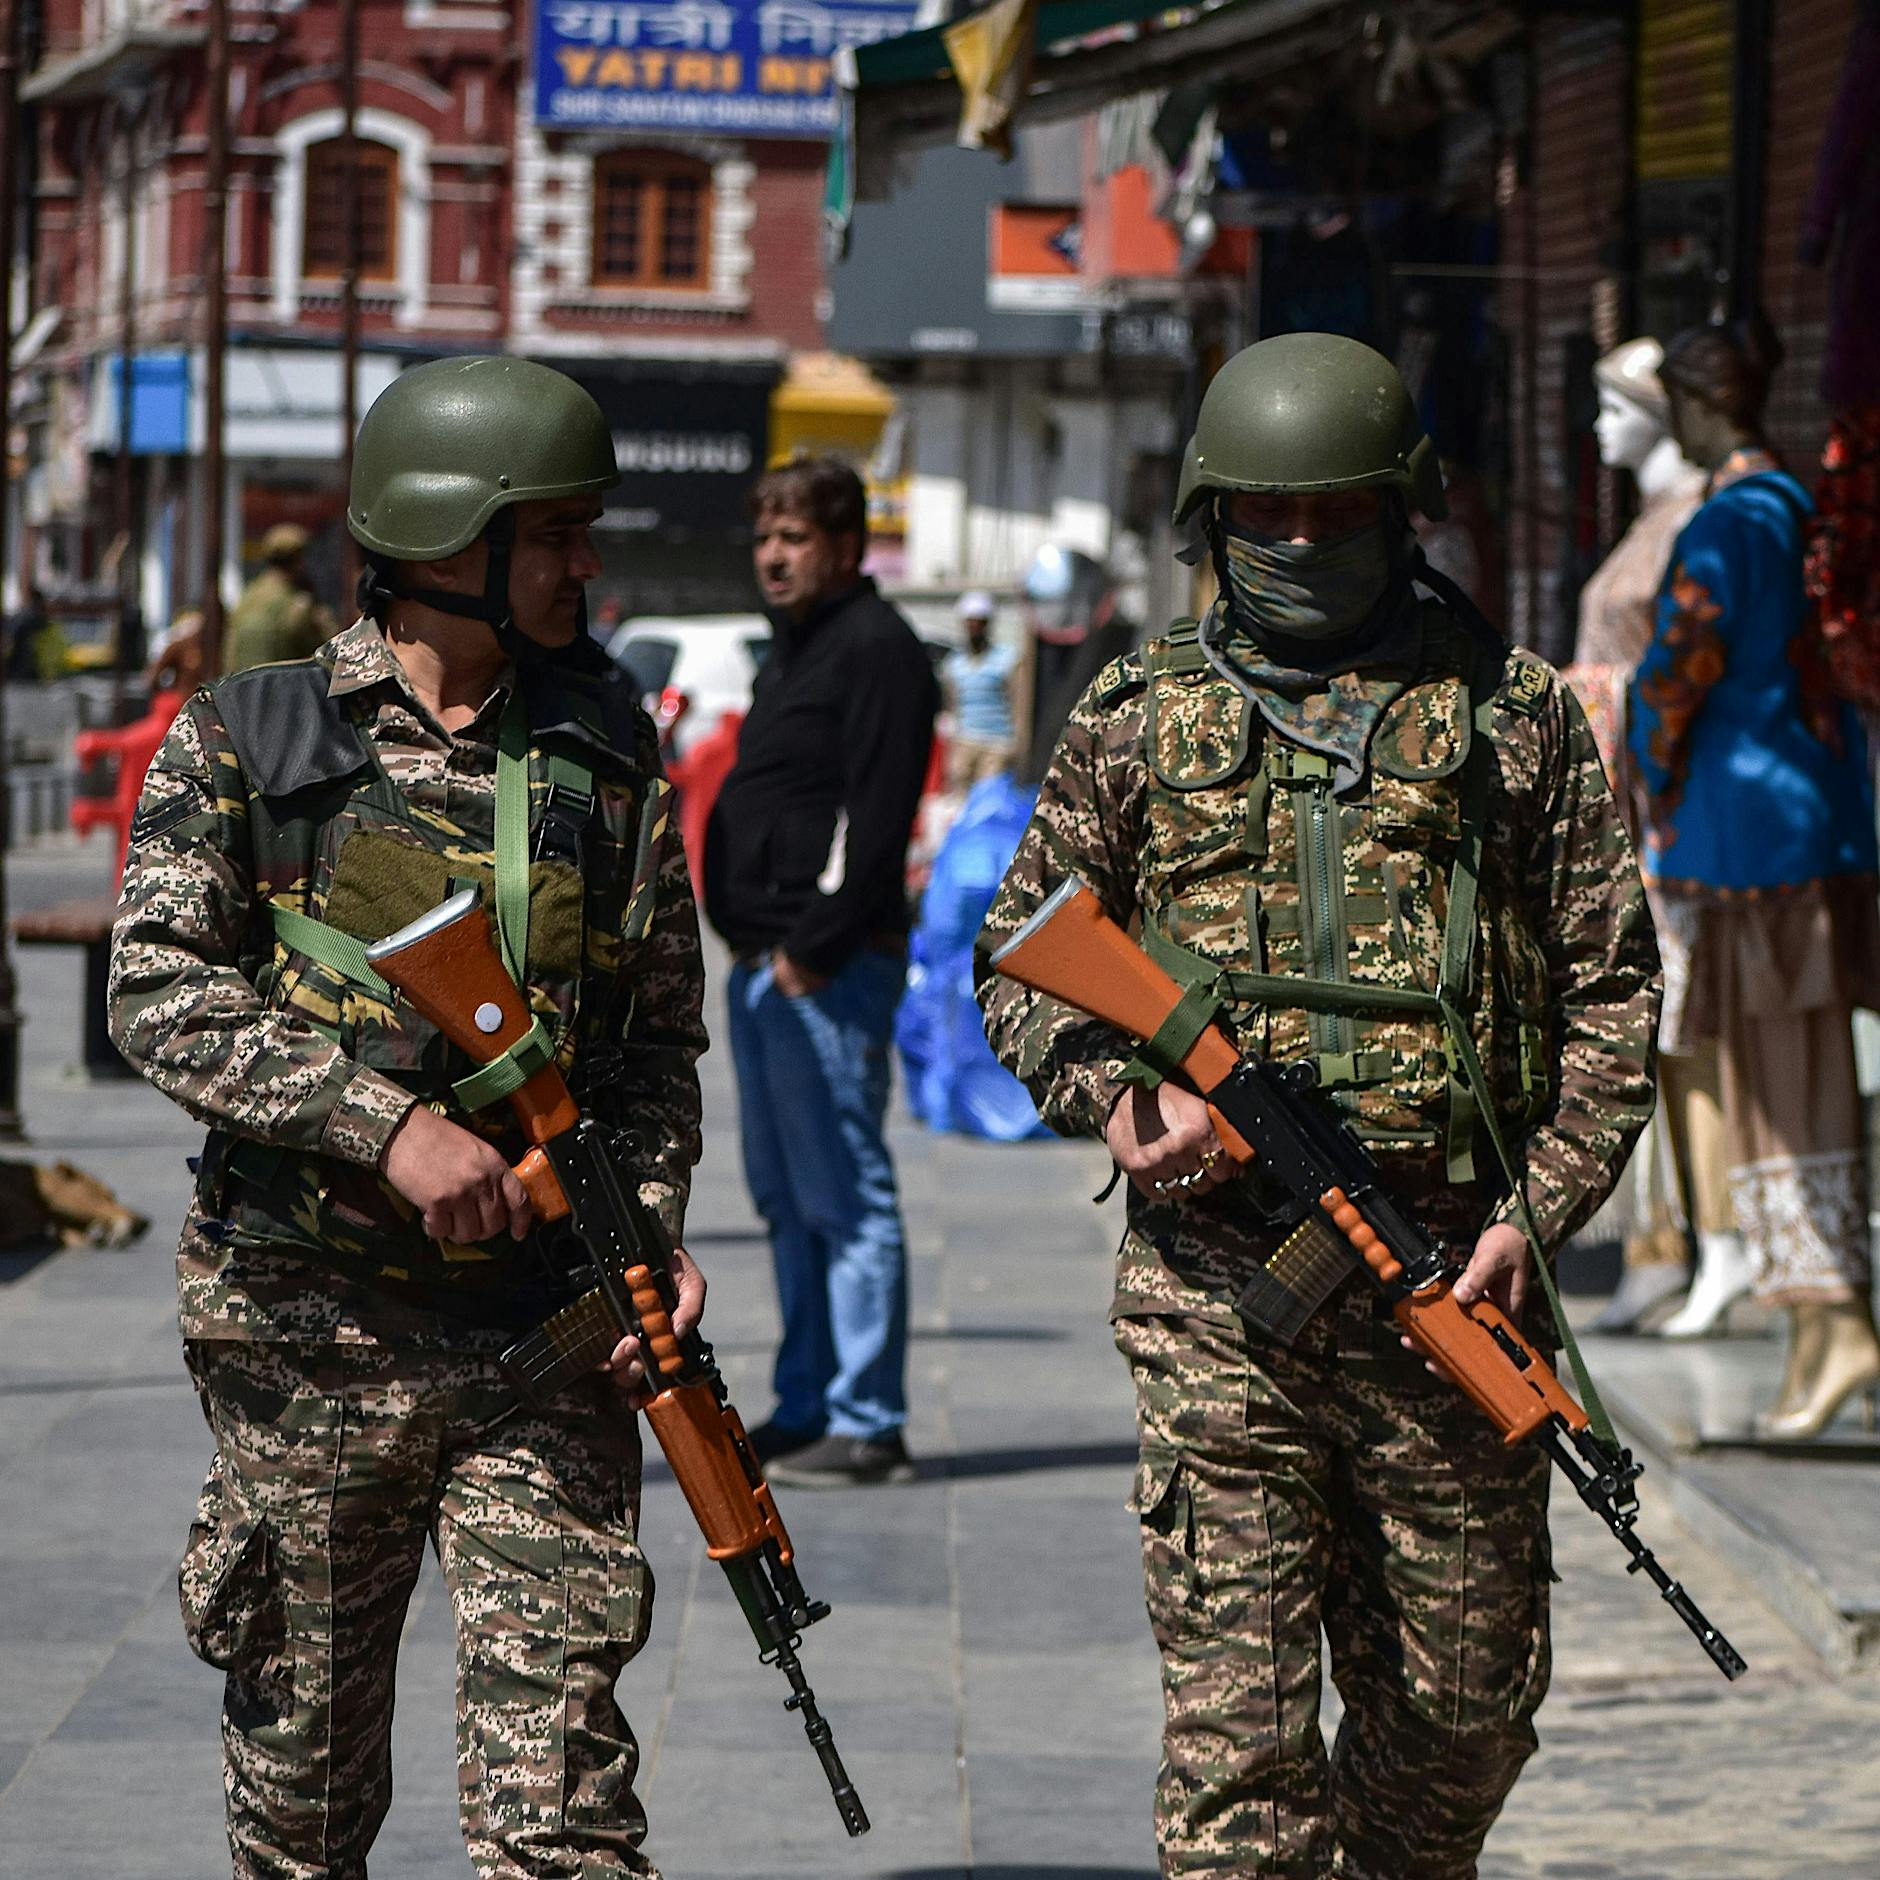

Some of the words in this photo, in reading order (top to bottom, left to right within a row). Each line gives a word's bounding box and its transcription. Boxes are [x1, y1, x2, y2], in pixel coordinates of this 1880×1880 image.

[556, 46, 741, 93] YATRI
[756, 56, 832, 95] NI
[612, 433, 752, 473] MSUNG
